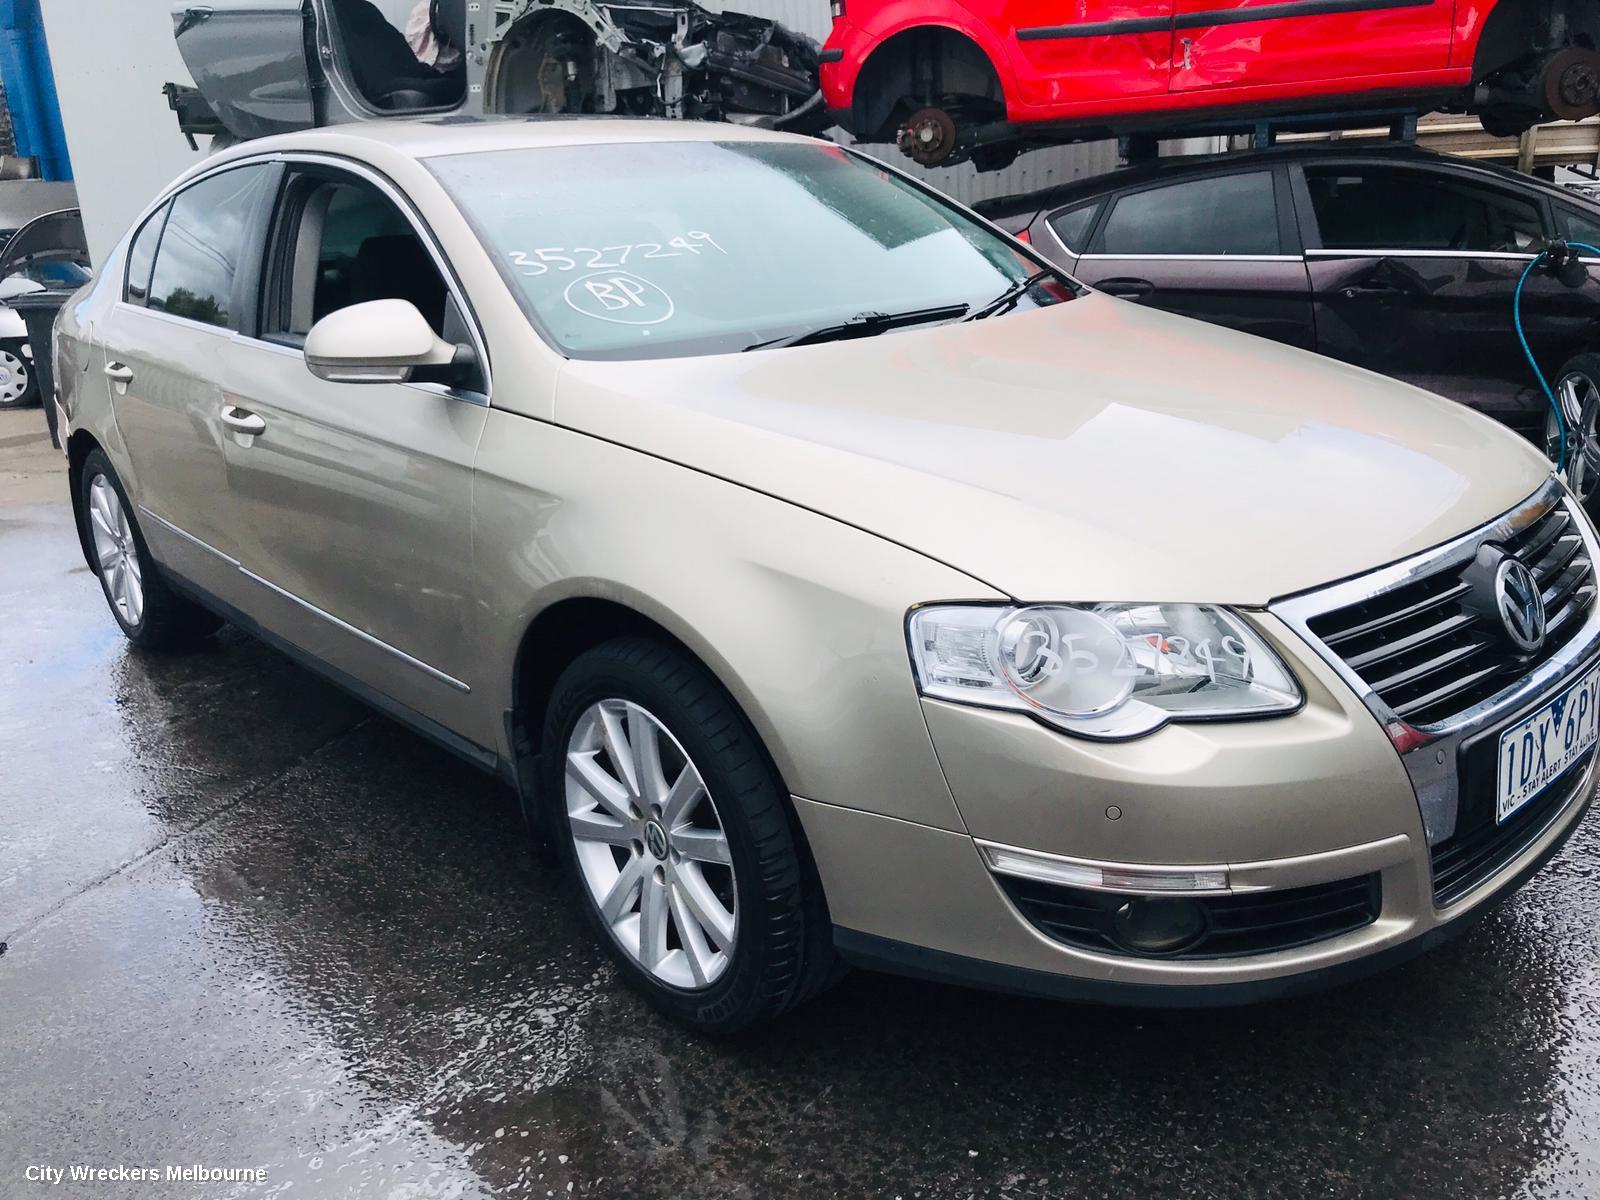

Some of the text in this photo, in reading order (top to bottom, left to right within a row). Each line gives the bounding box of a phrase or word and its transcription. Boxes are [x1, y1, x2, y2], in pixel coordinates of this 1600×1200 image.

[584, 277, 645, 310] BP
[1507, 676, 1600, 795] 1DX 6PY
[1502, 794, 1515, 812] VIC
[1522, 775, 1541, 798] STAY
[1541, 758, 1562, 782] ALERT
[1564, 745, 1579, 764] STAY
